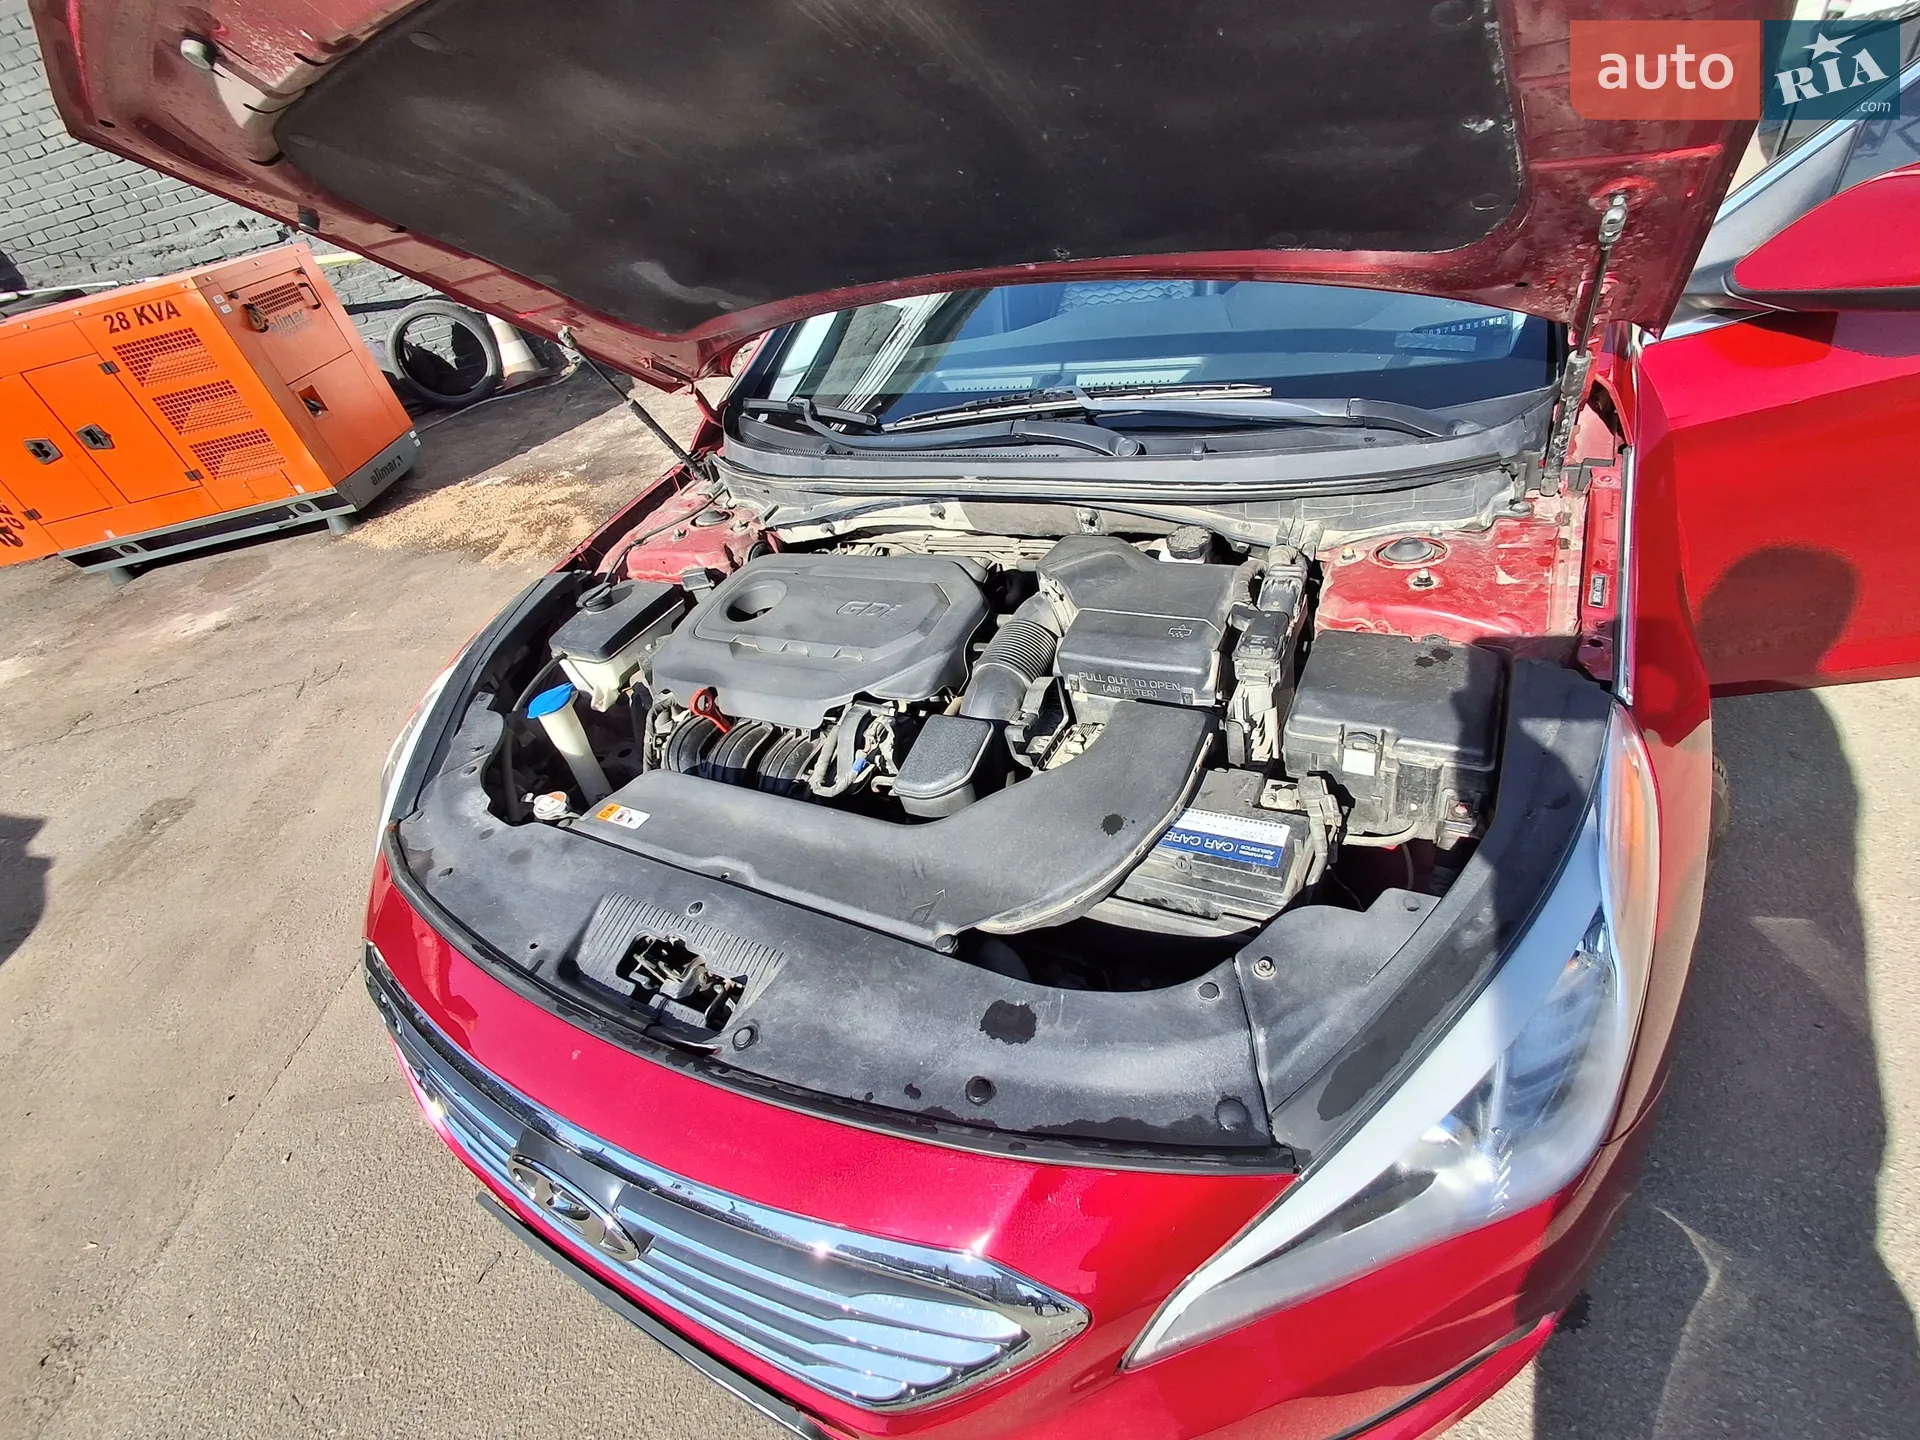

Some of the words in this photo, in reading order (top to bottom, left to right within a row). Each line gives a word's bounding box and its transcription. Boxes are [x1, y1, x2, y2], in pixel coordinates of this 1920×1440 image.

[103, 311, 131, 334] 28
[132, 300, 182, 327] KVA
[269, 308, 305, 333] alimar
[370, 459, 398, 486] alimar
[1079, 671, 1106, 683] PULL
[1107, 675, 1129, 686] OUT
[1131, 678, 1147, 689] TO
[1149, 680, 1180, 692] OPEN
[1164, 831, 1201, 846] CARE
[1204, 840, 1234, 852] CAR
